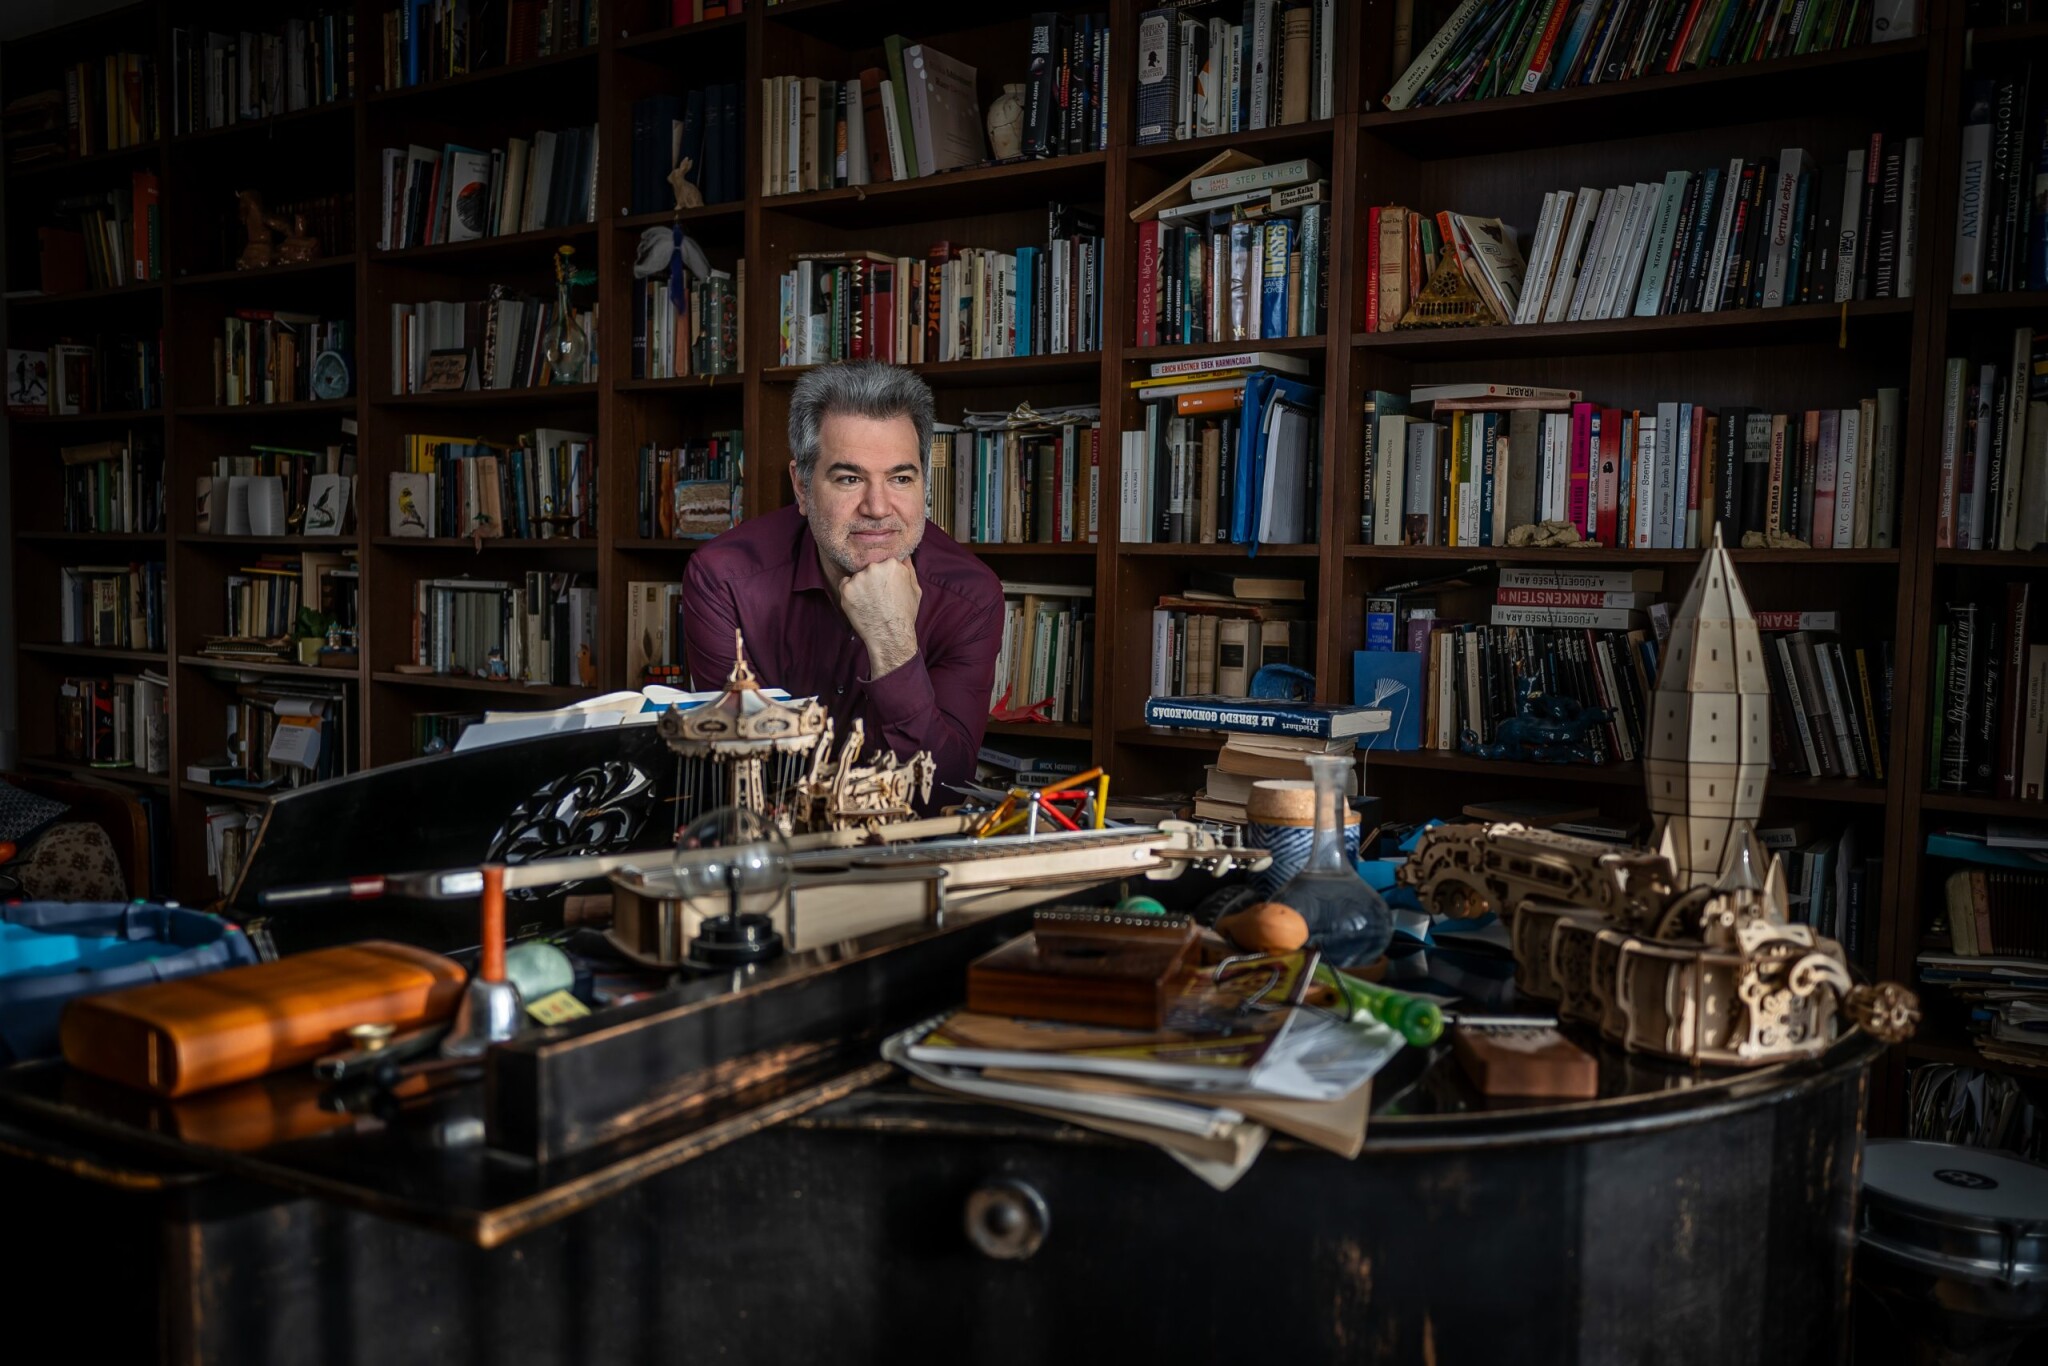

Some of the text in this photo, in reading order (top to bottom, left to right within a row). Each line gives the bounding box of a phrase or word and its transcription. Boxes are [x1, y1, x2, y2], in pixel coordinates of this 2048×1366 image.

[1505, 387, 1534, 397] KRABAT
[1844, 419, 1855, 464] AUSTERLITZ
[1841, 471, 1852, 509] SEBALD
[1509, 591, 1604, 606] FRANKENSTEIN
[1152, 707, 1217, 722] GONDOLKODÁS
[1261, 716, 1275, 728] AZ
